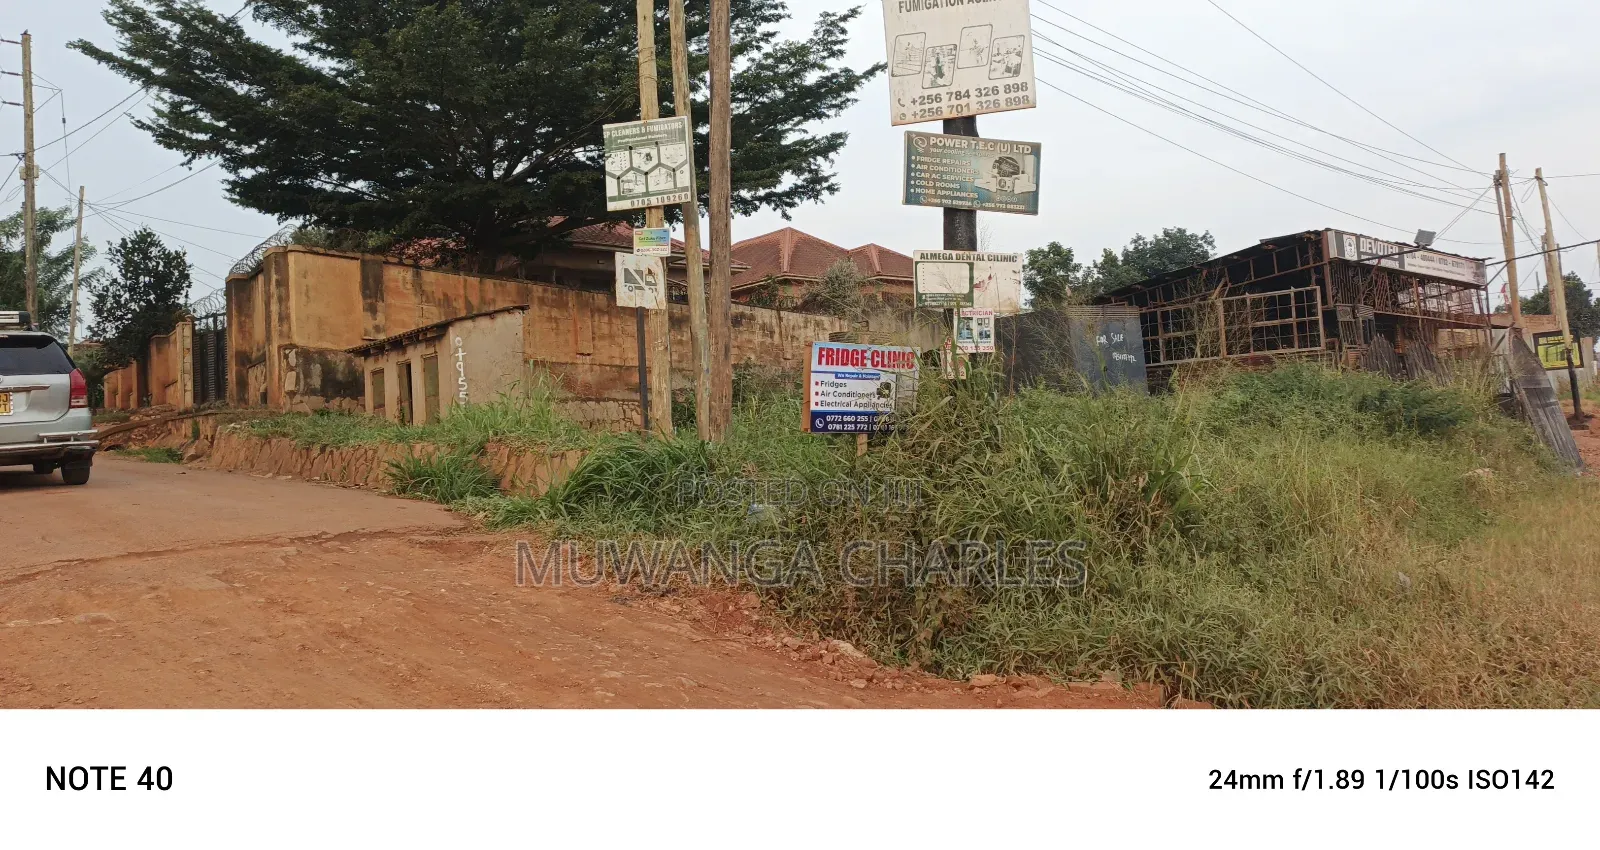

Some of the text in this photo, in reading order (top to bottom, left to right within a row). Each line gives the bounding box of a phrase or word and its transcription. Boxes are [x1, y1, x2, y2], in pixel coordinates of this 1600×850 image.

[911, 82, 1029, 106] +256 784 326 898
[911, 95, 1030, 119] +256 701 326 898
[611, 127, 640, 137] CLEANERS
[646, 121, 683, 132] FUMIGATORS
[929, 136, 969, 149] POWER
[970, 140, 995, 151] T.E.C
[997, 143, 1011, 154] (U)
[1013, 144, 1032, 154] LTD
[916, 155, 972, 166] FRIDGE REPAIRS
[915, 163, 980, 175] AIR CONDITIONERS
[915, 171, 930, 179] CAR
[942, 173, 974, 182] SERVICES
[915, 179, 960, 189] COLD ROOMS
[655, 193, 689, 202] 109260
[915, 187, 979, 198] HOME APPLIANCES
[920, 252, 1018, 263] ALMEGA DENTAL CILINIC
[1111, 333, 1124, 344] SALE
[817, 346, 916, 370] FRIDGE CLINIC
[820, 380, 847, 388] Fridges
